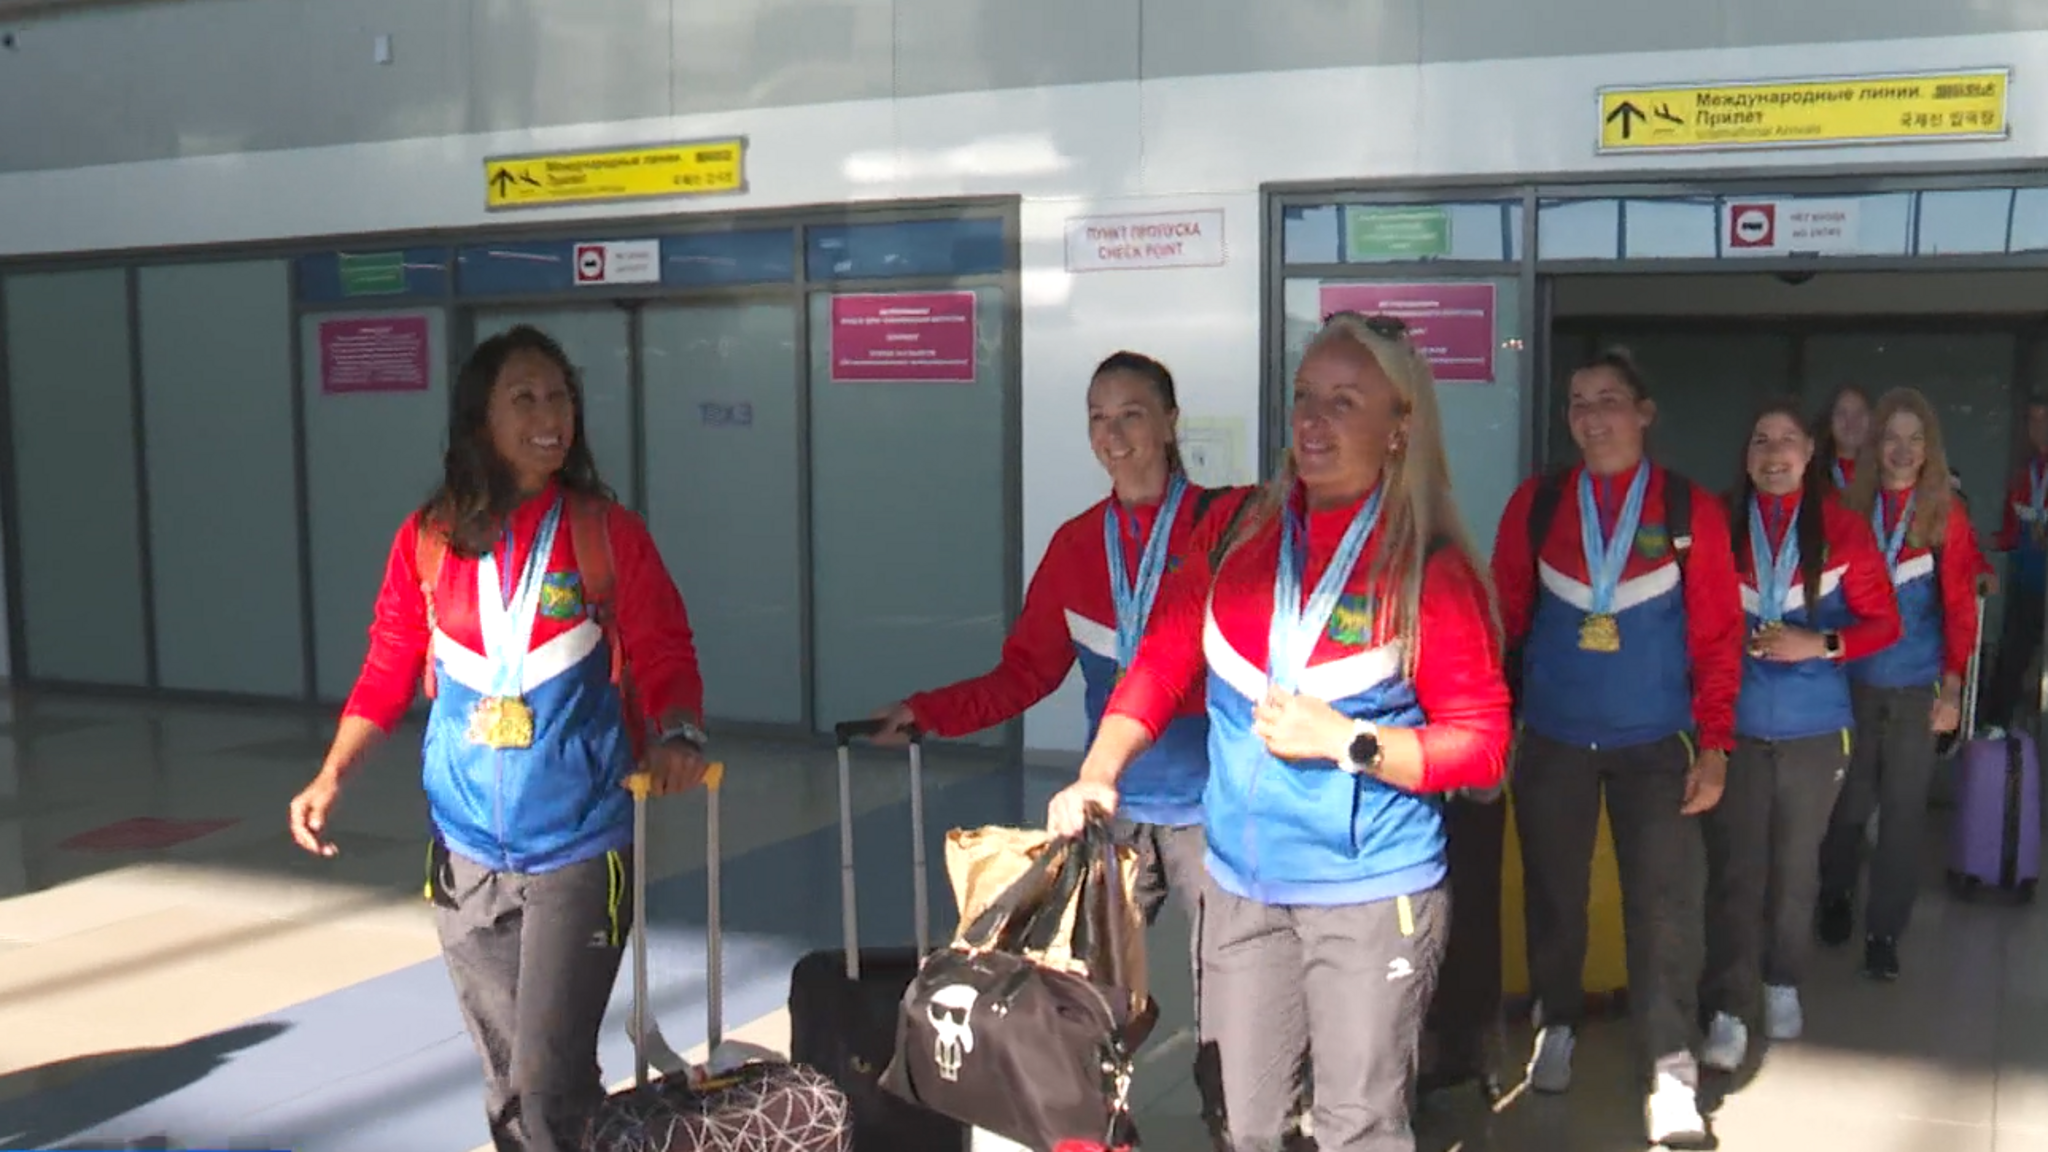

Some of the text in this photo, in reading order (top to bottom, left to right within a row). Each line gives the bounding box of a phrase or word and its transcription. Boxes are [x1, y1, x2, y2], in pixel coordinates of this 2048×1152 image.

[1695, 89, 1855, 108] Международные
[1859, 86, 1920, 100] линии
[1131, 222, 1202, 238] ПРОПУСКА
[1098, 243, 1184, 260] CHECK POINT
